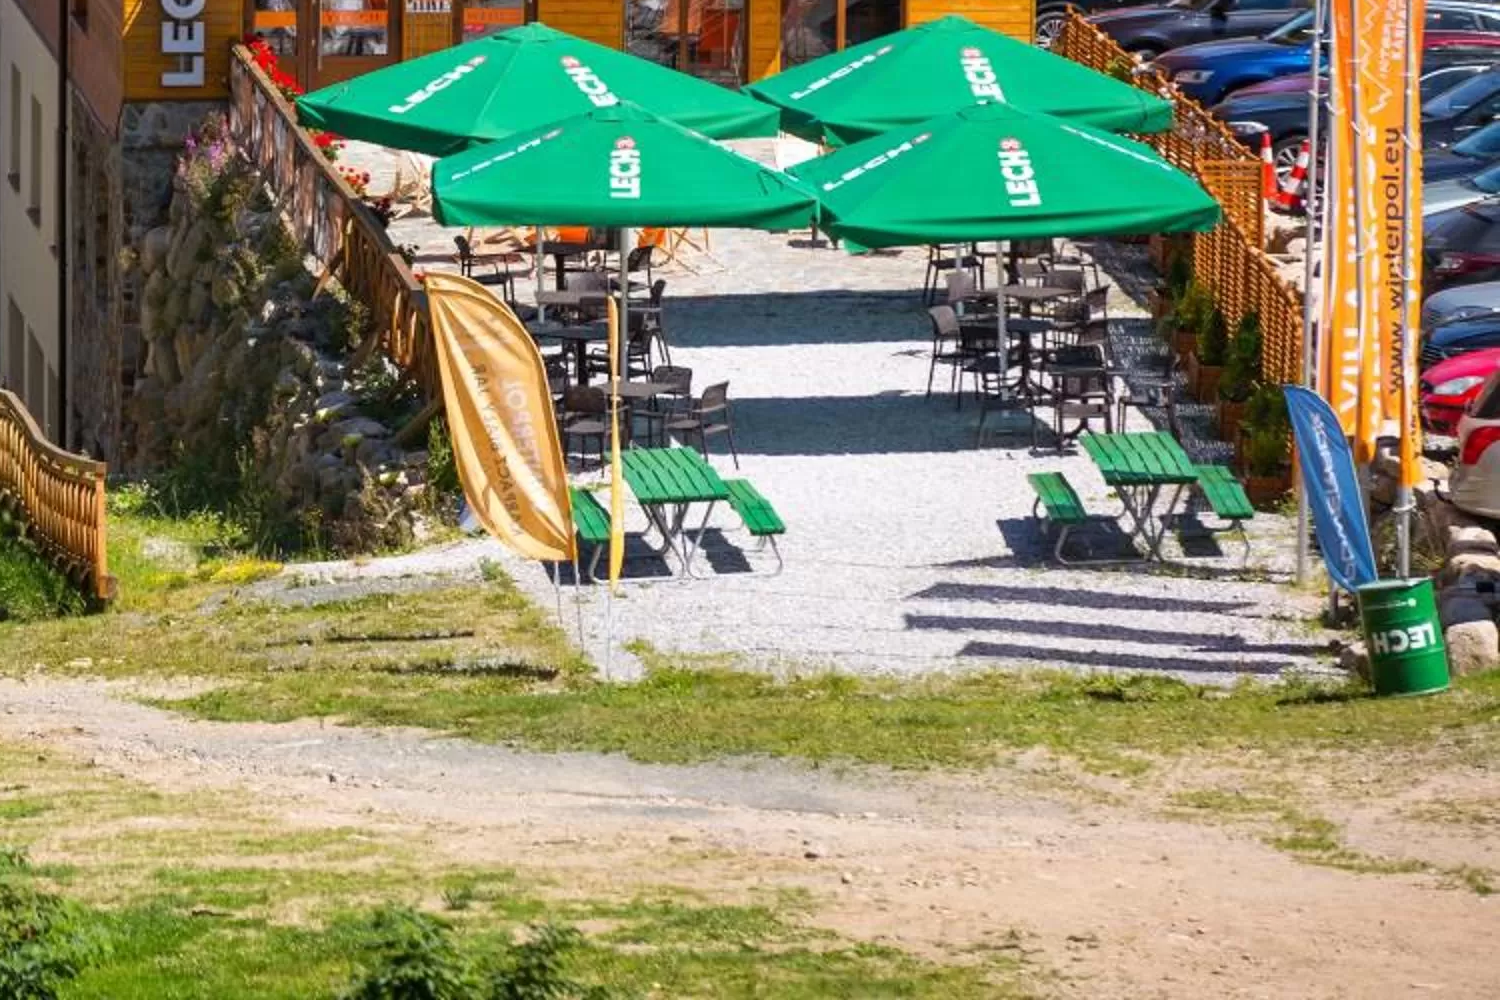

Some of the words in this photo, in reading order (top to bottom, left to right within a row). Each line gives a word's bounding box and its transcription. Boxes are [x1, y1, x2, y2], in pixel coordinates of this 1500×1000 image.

[565, 65, 620, 107] ECH
[610, 149, 641, 199] LECH
[997, 150, 1042, 207] LECH
[1381, 128, 1405, 395] wwwwinterpol.eu
[1371, 622, 1437, 654] LECH
